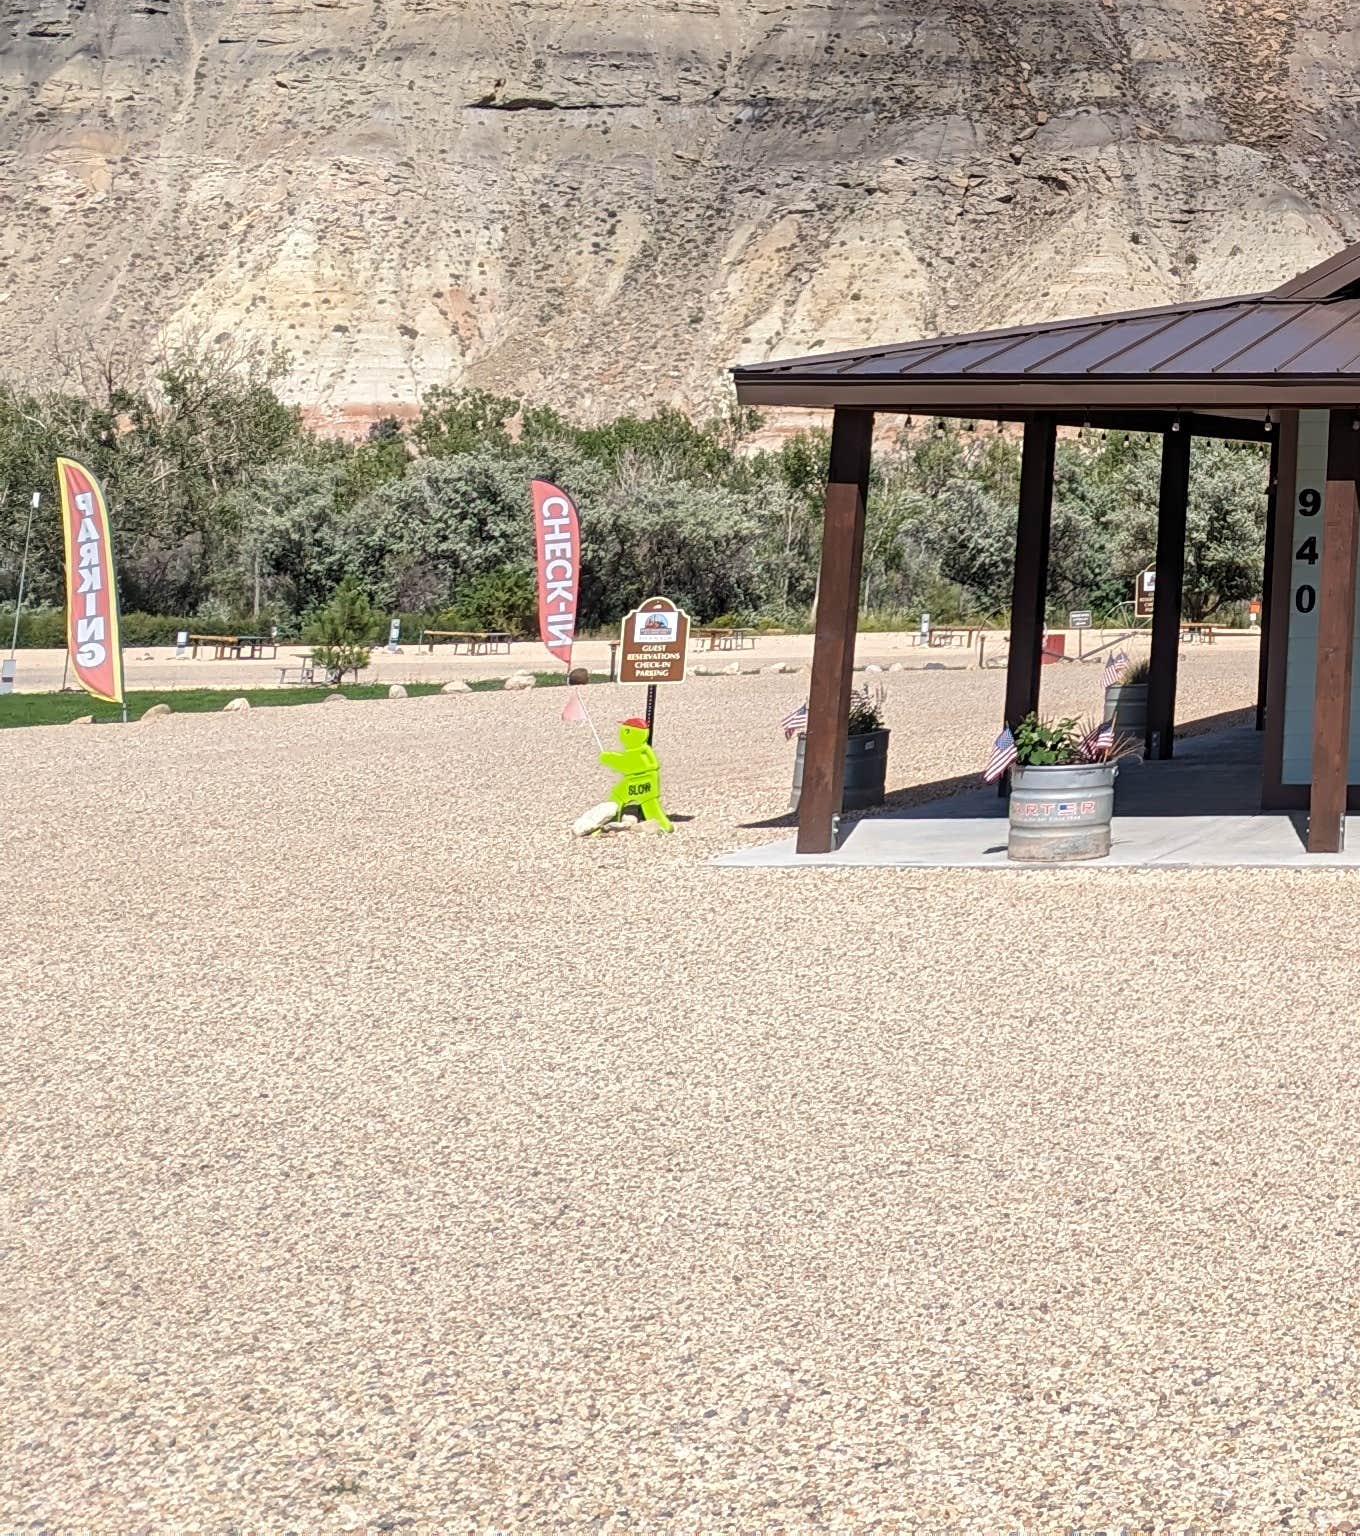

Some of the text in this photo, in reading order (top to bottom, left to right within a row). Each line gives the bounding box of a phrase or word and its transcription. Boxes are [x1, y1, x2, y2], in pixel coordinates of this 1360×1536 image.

[627, 653, 680, 661] RESERVATIONS
[634, 661, 671, 669] CHECK-IN
[635, 669, 669, 677] PARKING
[628, 783, 651, 795] SLOW
